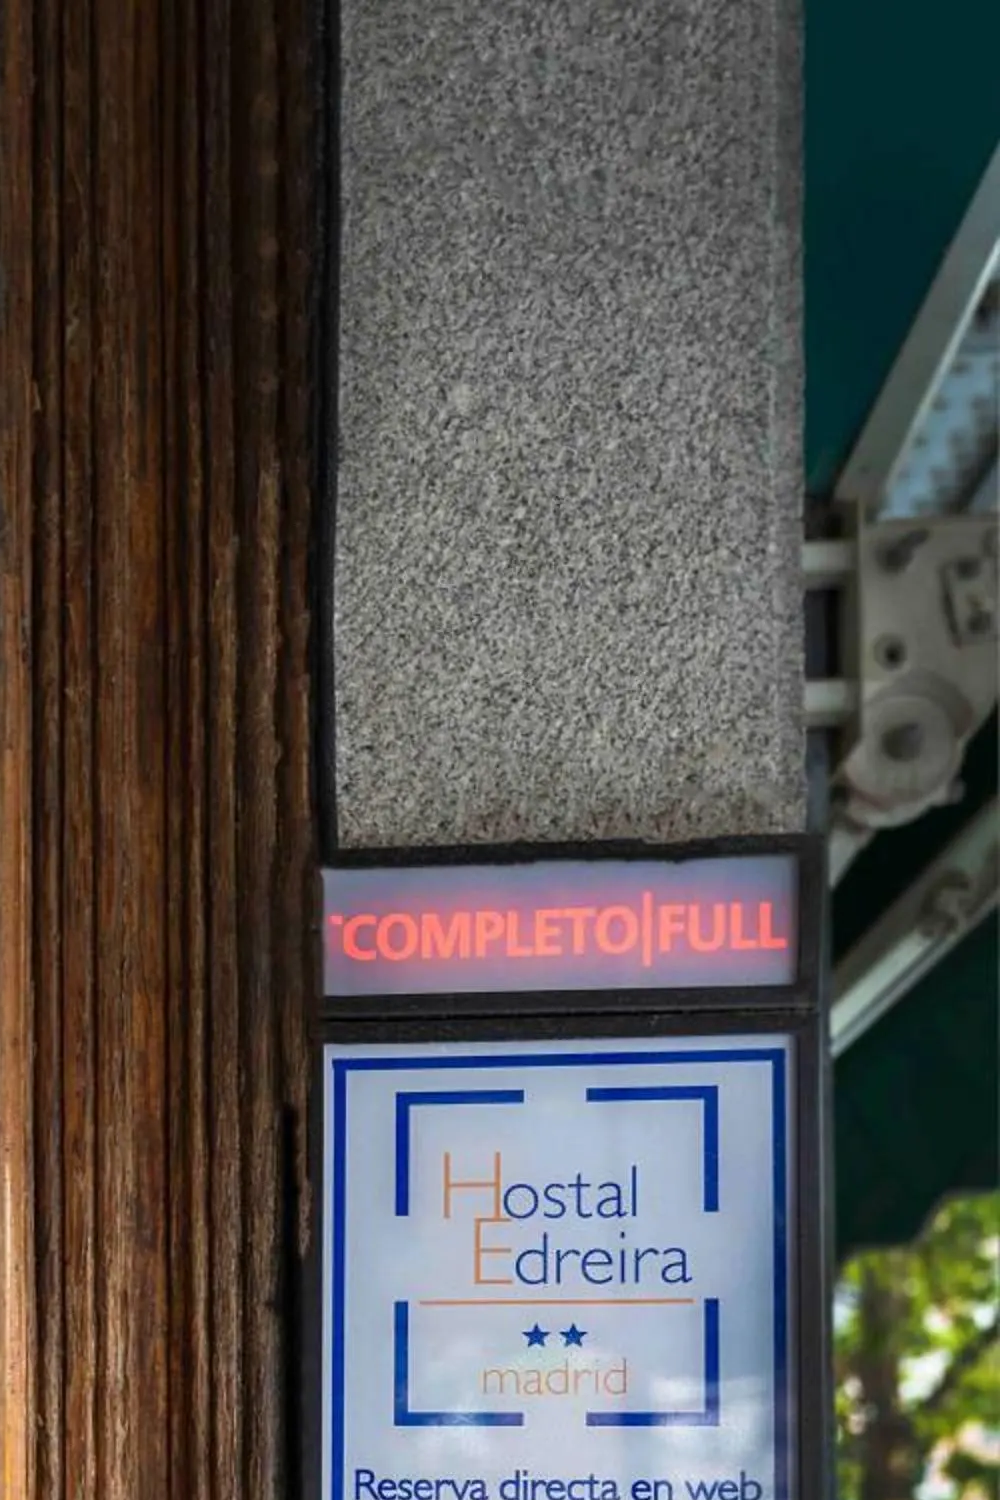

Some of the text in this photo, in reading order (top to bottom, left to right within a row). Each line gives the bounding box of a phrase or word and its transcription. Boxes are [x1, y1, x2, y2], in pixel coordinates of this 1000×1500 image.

[443, 1152, 639, 1220] Hostal
[473, 1217, 693, 1286] Edreira
[481, 1357, 628, 1397] madrid
